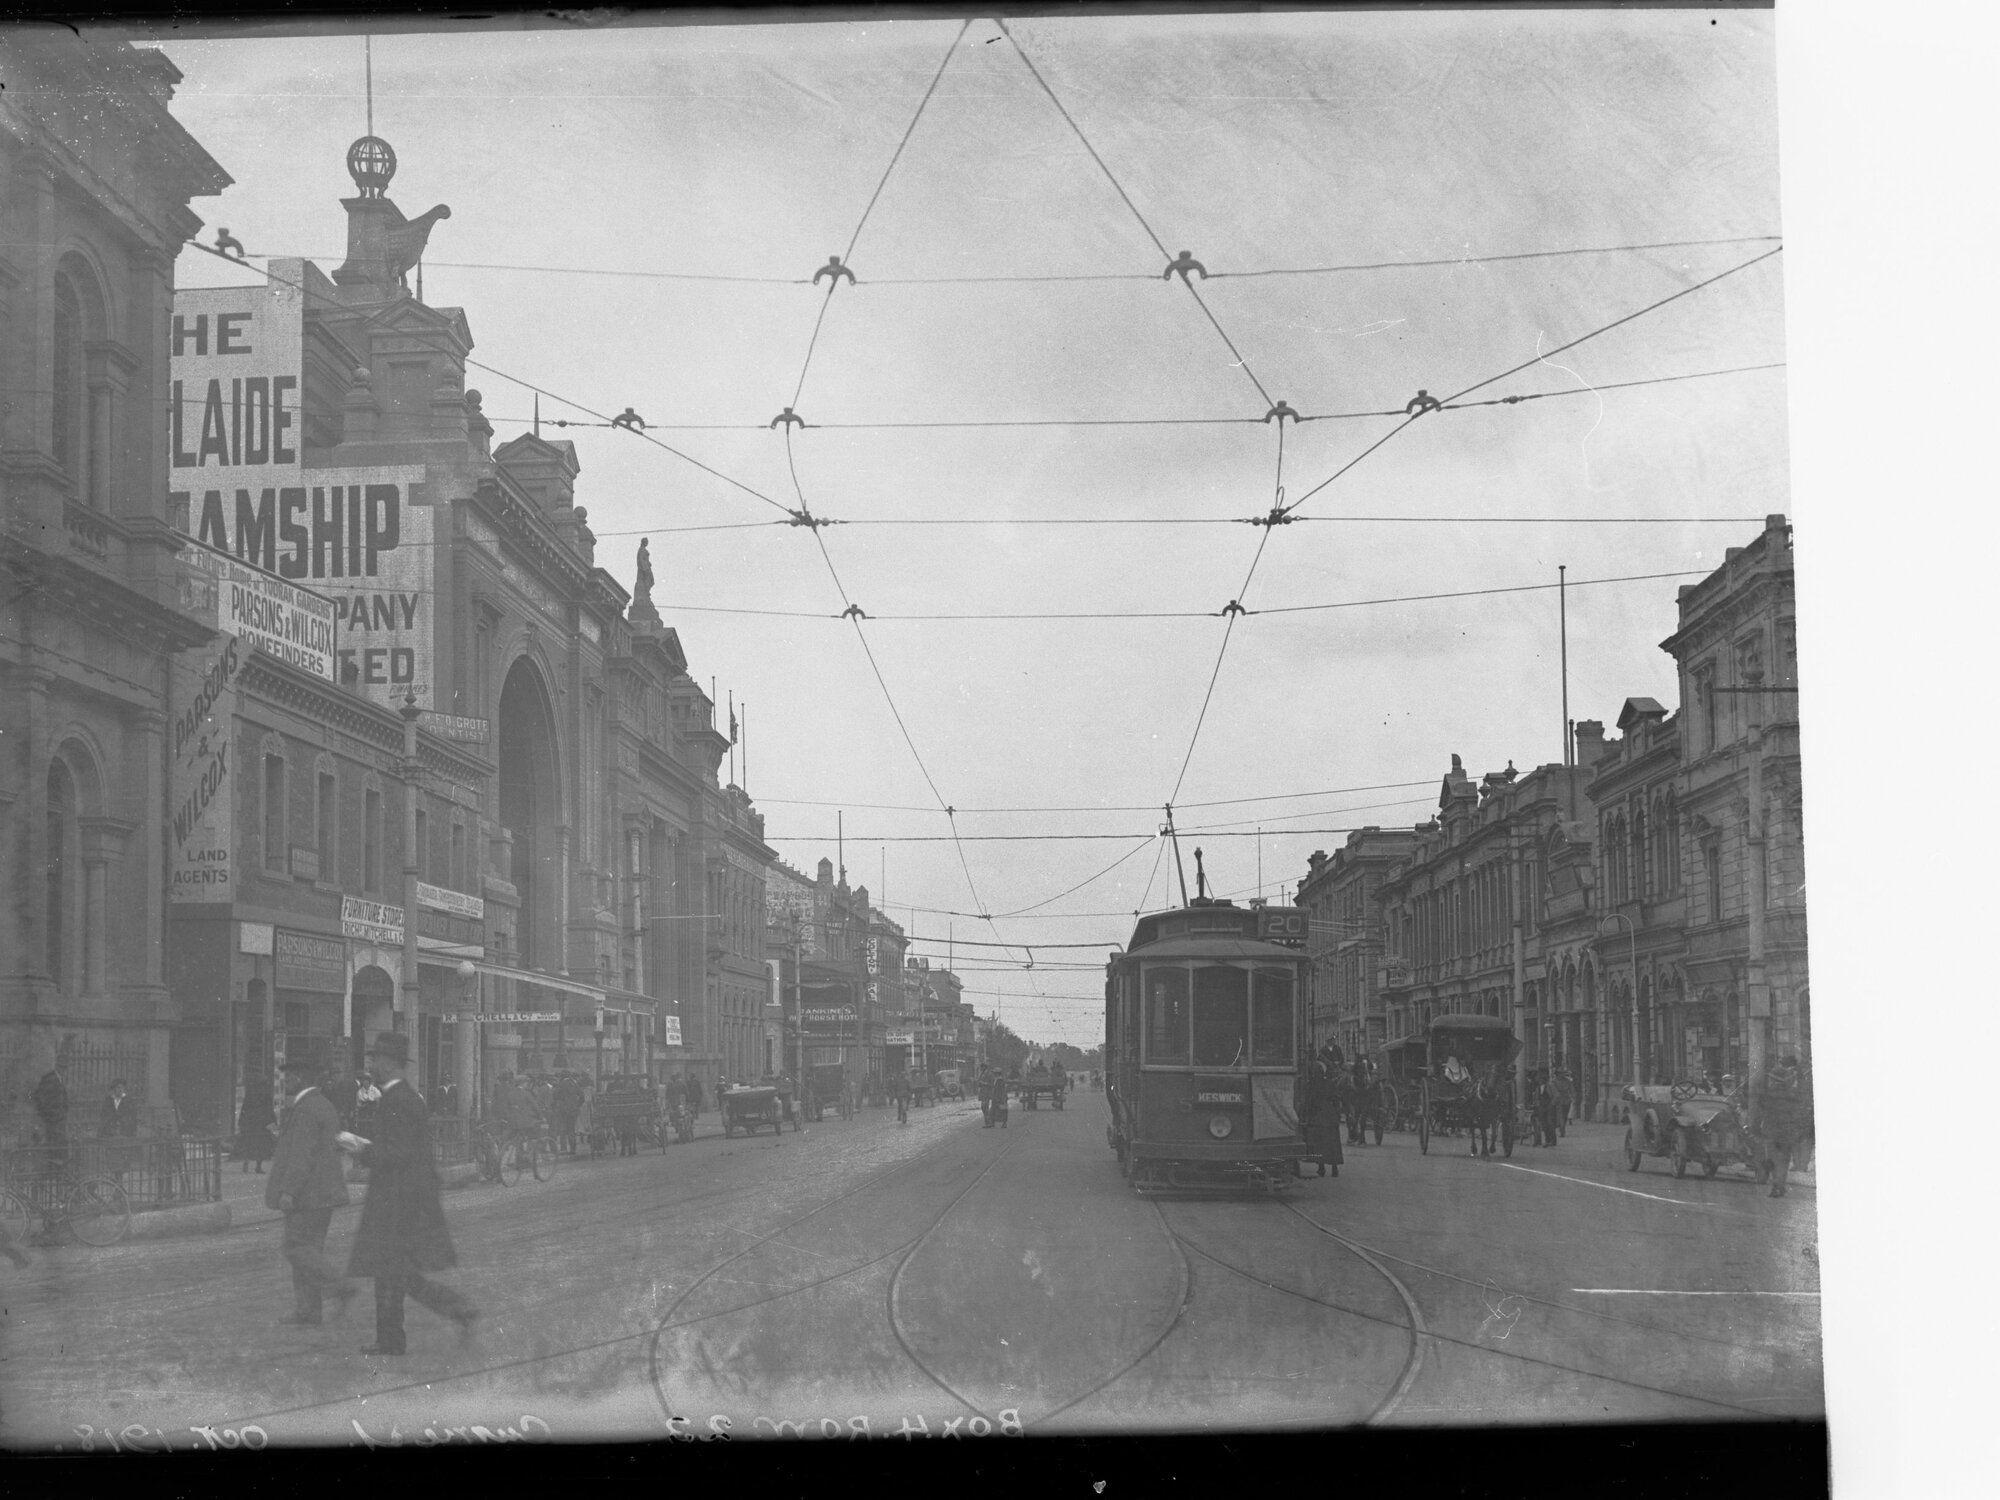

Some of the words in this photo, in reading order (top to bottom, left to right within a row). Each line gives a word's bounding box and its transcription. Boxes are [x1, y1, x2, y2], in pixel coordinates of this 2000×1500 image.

[172, 484, 400, 580] AMSHIP
[232, 584, 284, 638] PARSONS
[285, 616, 291, 641] &
[291, 608, 333, 658] WILCOX
[238, 627, 325, 675] HOMEFINDERS
[175, 637, 237, 759] PARSONS
[429, 724, 484, 741] DENTIST
[456, 717, 489, 732] GROTE
[198, 736, 209, 758] &
[173, 740, 228, 848] WILCOX
[187, 849, 228, 863] LAND
[173, 869, 229, 885] AGENTS
[343, 898, 381, 924] FURNITURE
[382, 906, 404, 927] STORE
[1268, 915, 1302, 934] 20
[277, 934, 313, 957] PARSONS
[809, 1014, 836, 1022] HORSE
[1198, 1092, 1242, 1103] KESWICK
